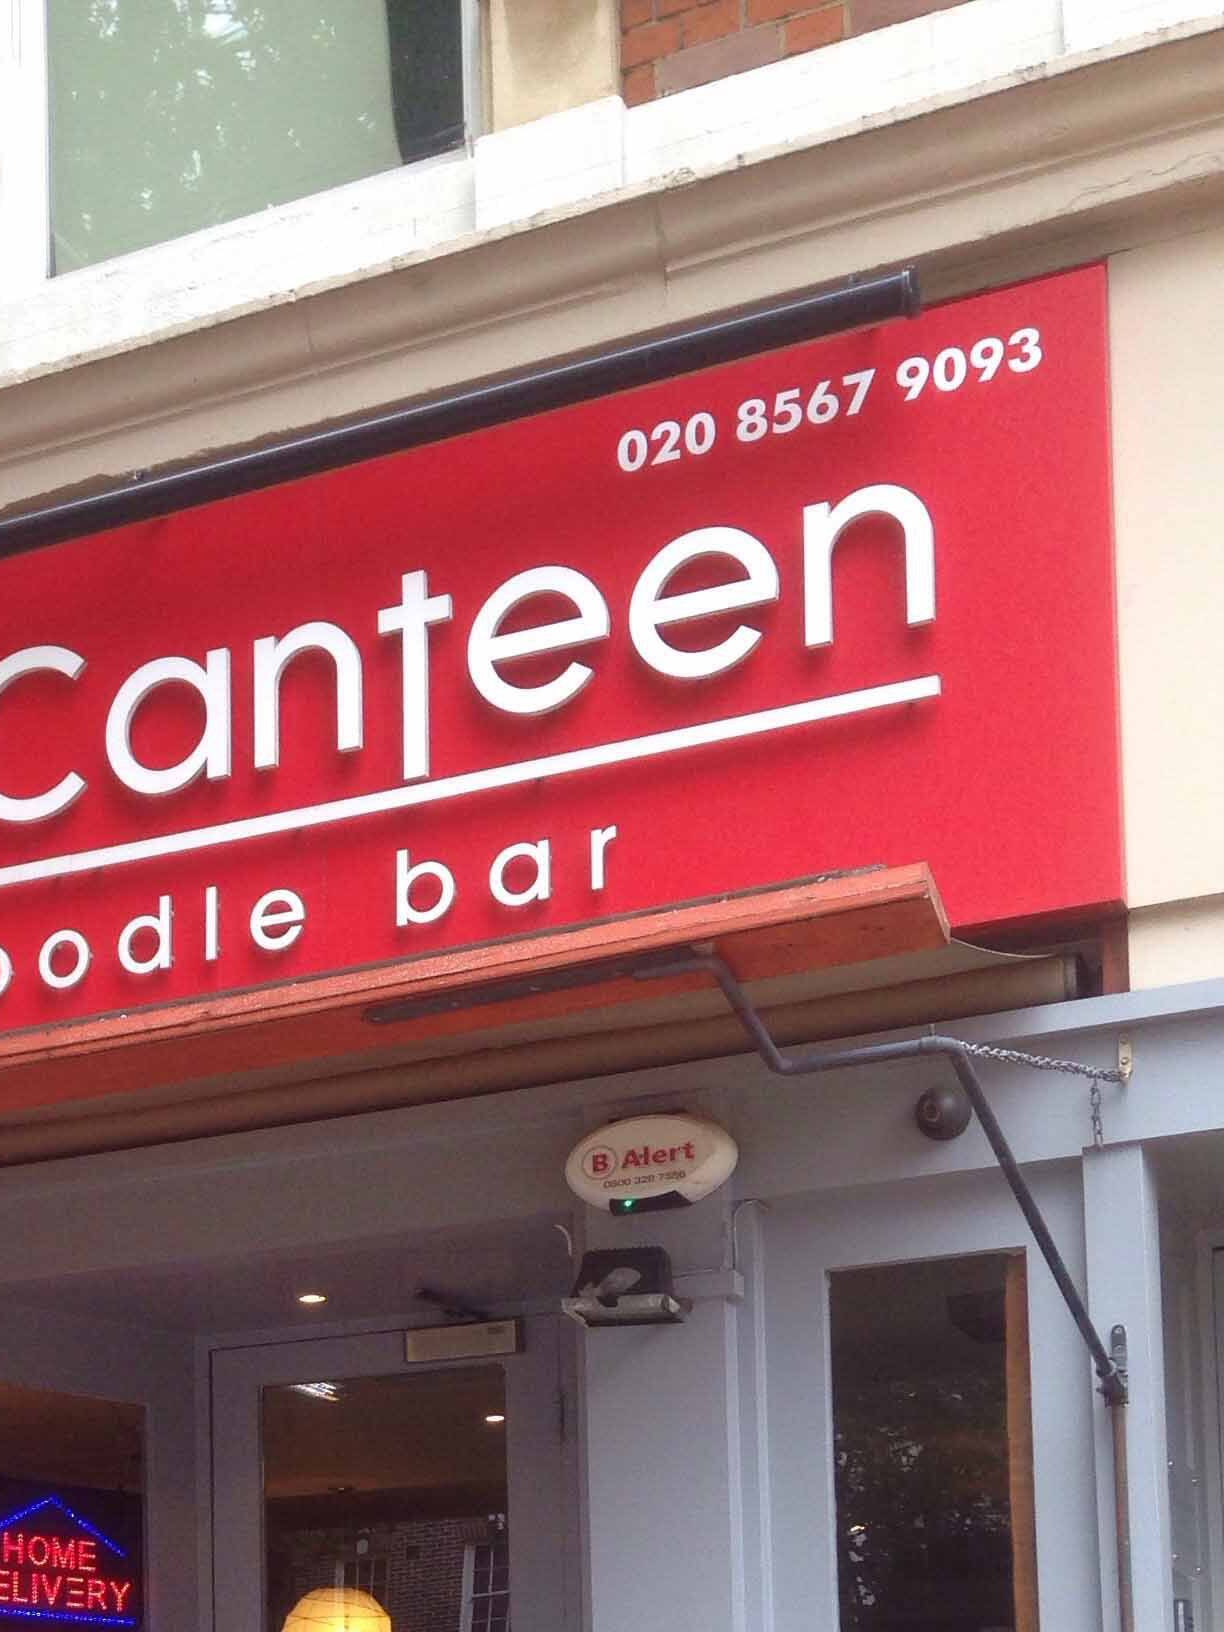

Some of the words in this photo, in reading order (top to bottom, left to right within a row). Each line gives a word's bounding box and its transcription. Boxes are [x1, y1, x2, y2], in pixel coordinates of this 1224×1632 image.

[617, 411, 716, 473] 020
[735, 368, 875, 443] 8567
[894, 326, 1043, 402] 9093
[395, 825, 616, 927] bar
[591, 1152, 609, 1173] B
[621, 1141, 695, 1169] Alert
[2, 1531, 97, 1572] HOME
